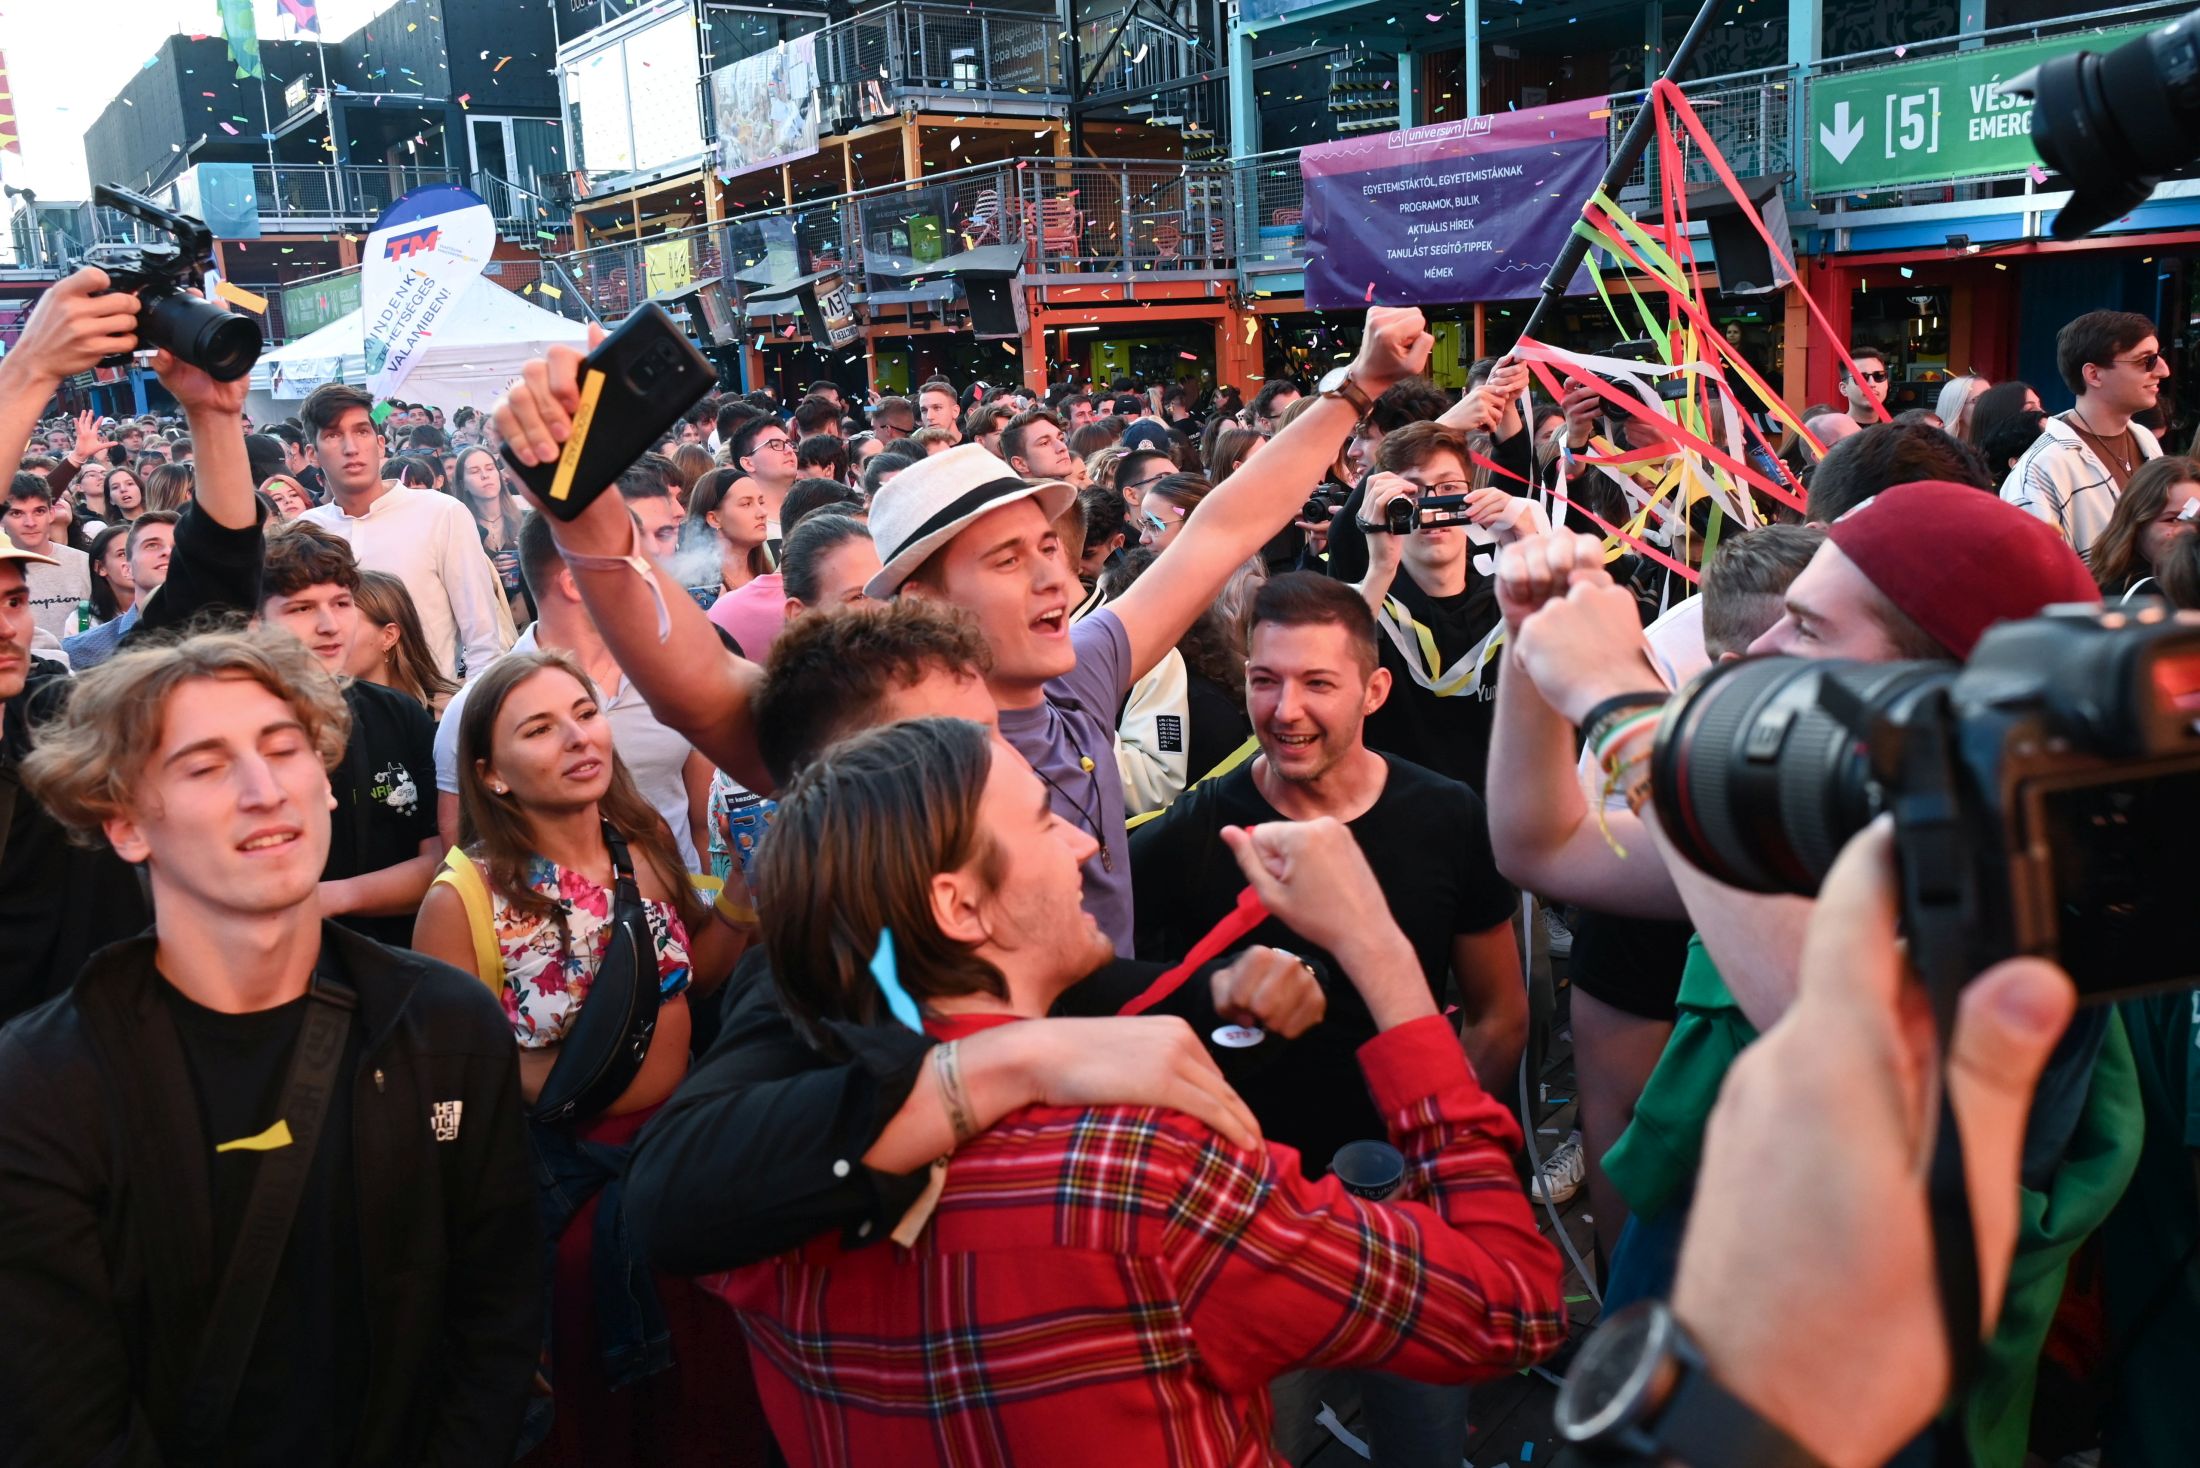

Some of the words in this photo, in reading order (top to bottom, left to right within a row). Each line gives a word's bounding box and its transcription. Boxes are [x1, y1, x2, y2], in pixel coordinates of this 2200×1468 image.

[1969, 110, 2032, 142] EMERG
[1362, 174, 1438, 196] EGYETEMISTÁKTÓL,
[1438, 164, 1523, 185] EGYETEMISTÁKNAK
[1399, 198, 1454, 214] PROGRAMOK,
[1455, 195, 1480, 207] BULIK
[1407, 220, 1448, 235] AKTUÁLIS
[1449, 217, 1475, 231] HÍREK
[1387, 244, 1428, 259] TANULÁST
[1430, 241, 1462, 256] SEGÍTŐ
[1463, 240, 1493, 252] TIPPEK
[1424, 265, 1454, 279] MÉMEK
[364, 268, 418, 352] MINDENKI
[376, 277, 435, 364] TEHETSÉGES
[387, 287, 452, 372] VALAMIBEN!
[29, 595, 80, 609] mpion
